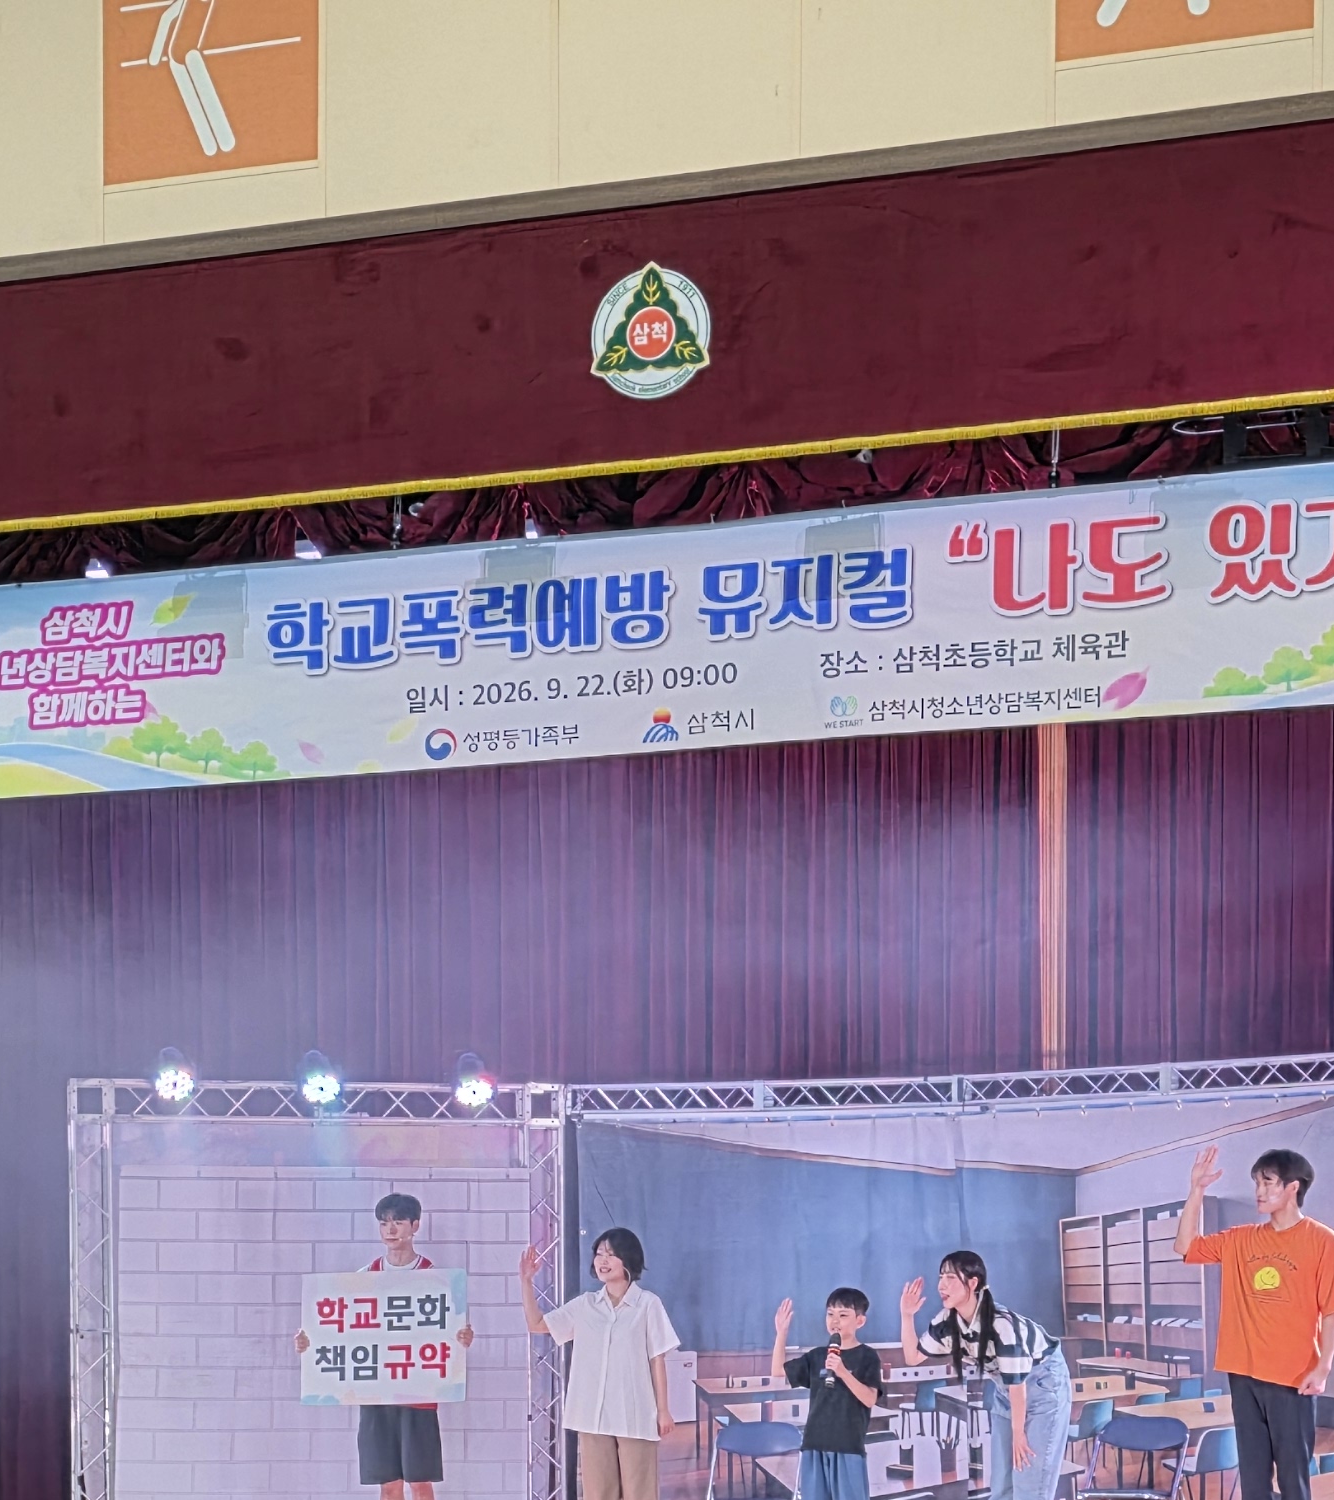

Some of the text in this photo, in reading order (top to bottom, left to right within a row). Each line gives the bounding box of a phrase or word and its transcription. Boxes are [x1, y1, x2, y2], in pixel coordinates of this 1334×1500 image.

[607, 280, 696, 306] SINCE 1911
[633, 321, 667, 345] 삼척
[43, 602, 130, 641] 삼척시
[267, 570, 672, 670] 학교폭력예방
[700, 548, 908, 636] 뮤지컬
[819, 650, 869, 679] 장소
[892, 638, 1044, 674] 삼척초등학교
[1052, 629, 1130, 663] 체육관
[406, 685, 450, 714] 일시
[473, 681, 539, 707] 2026.
[546, 678, 569, 702] 9.
[576, 669, 654, 700] 22.(화)
[663, 662, 738, 690] 09:00
[868, 685, 1102, 722] 삼척시청소년상담복지센터
[32, 690, 143, 726] 함께하는
[687, 708, 756, 733] 삼척시
[824, 718, 864, 729] WE START
[462, 721, 580, 754] 성평등가족부
[316, 1293, 450, 1333] 학교문화
[315, 1342, 451, 1381] 책임규약
